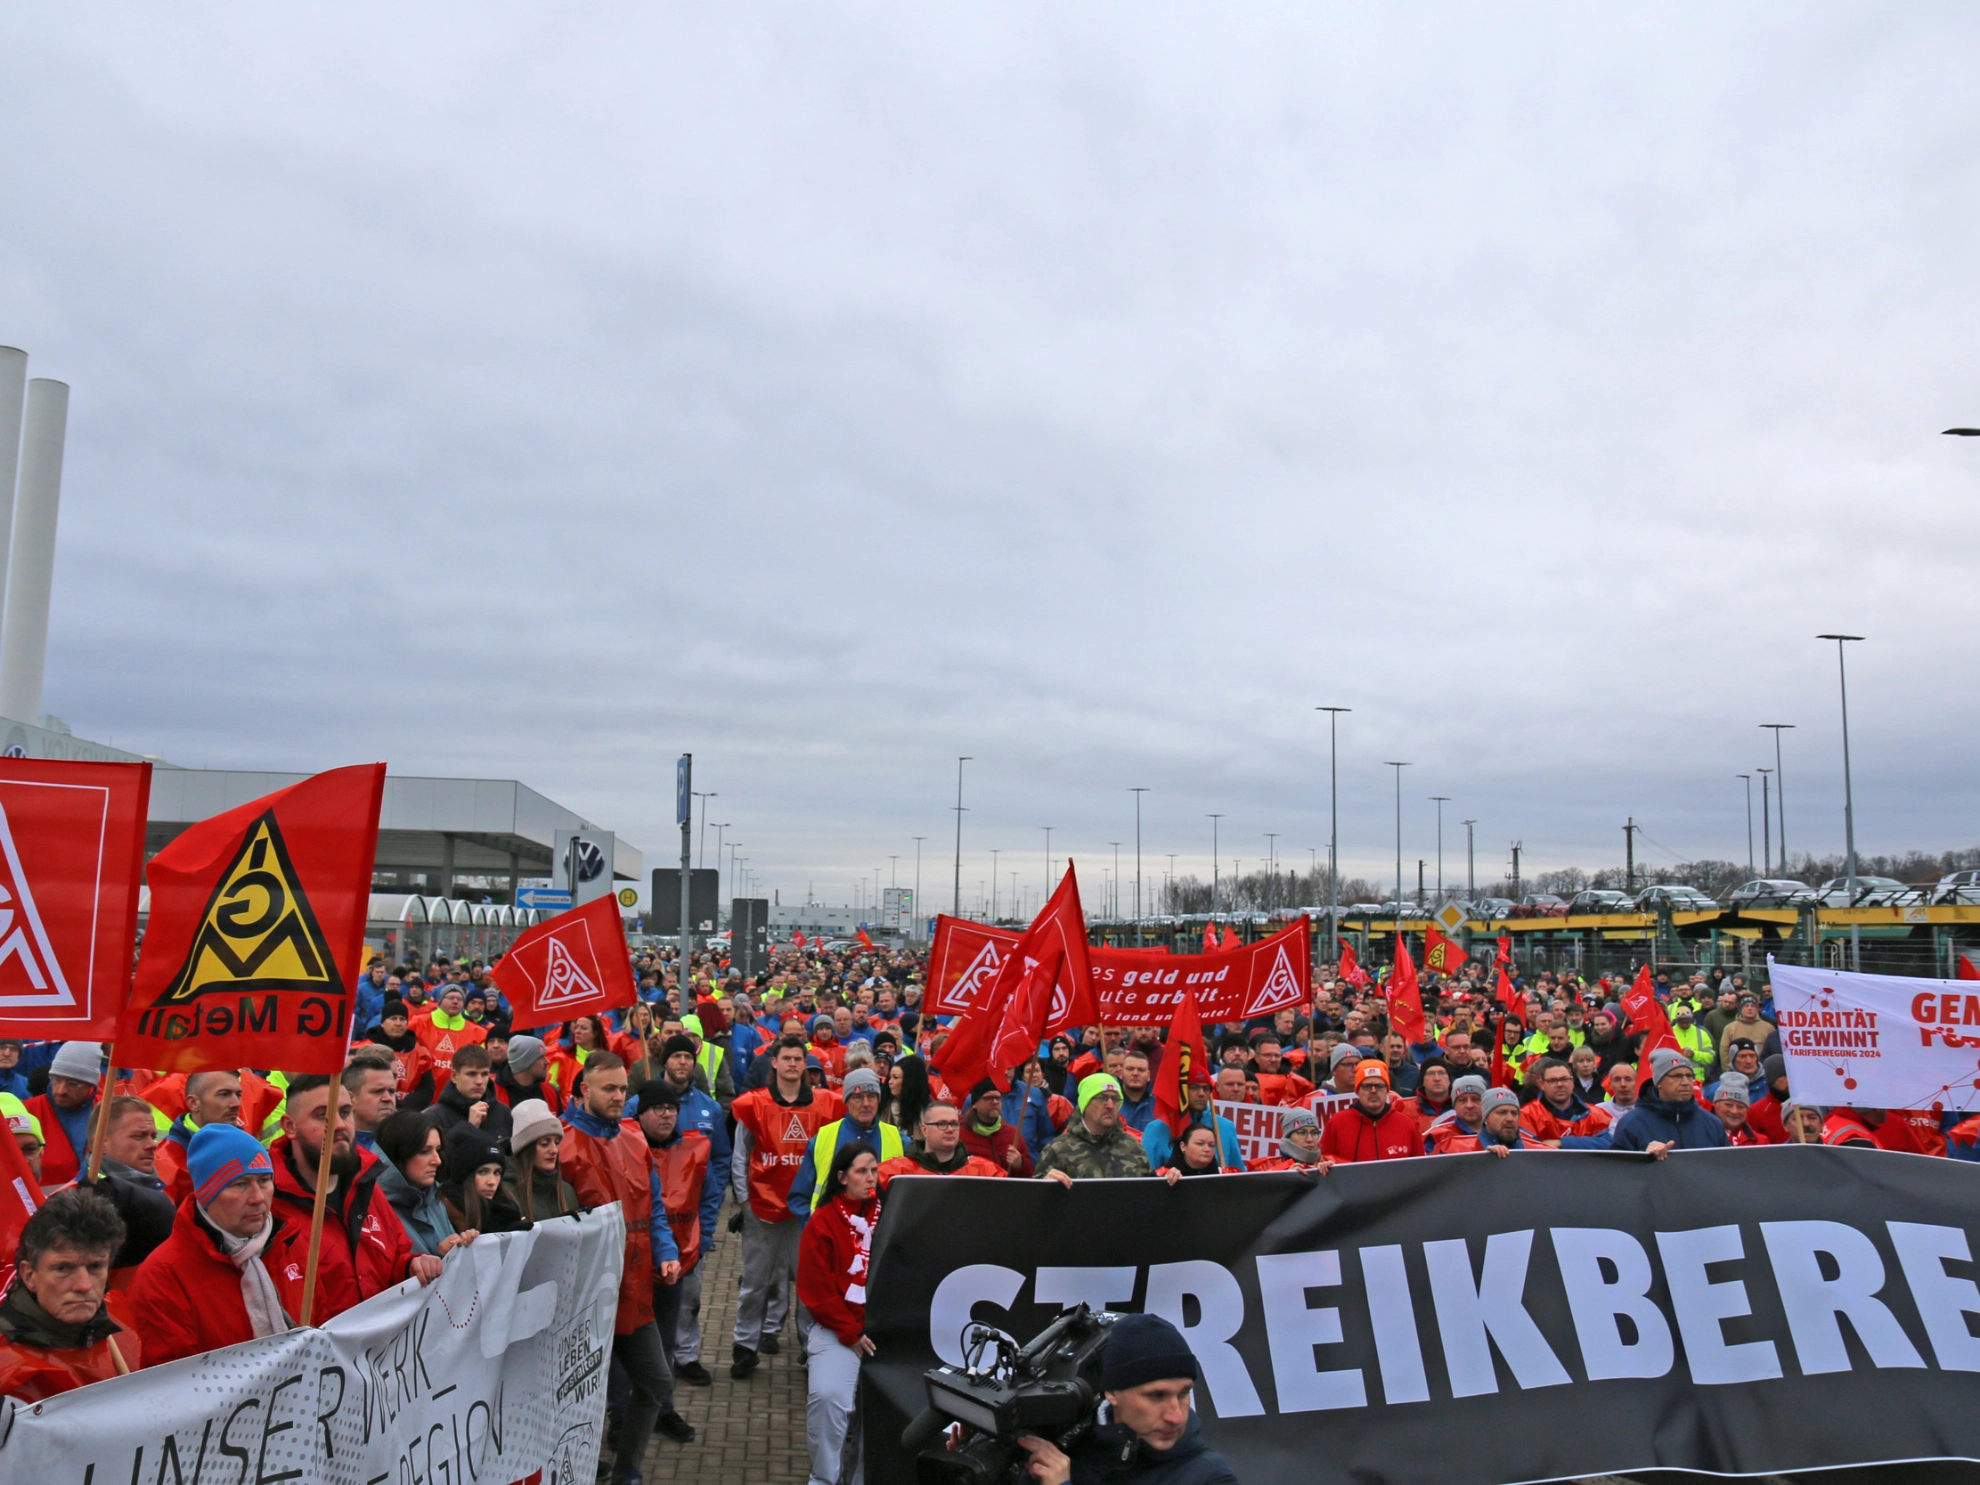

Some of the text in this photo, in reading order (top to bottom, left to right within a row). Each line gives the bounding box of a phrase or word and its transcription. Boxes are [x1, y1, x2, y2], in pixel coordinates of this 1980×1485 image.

[1121, 968, 1180, 987] geld
[1186, 965, 1230, 984] und
[1115, 1012, 1151, 1021] land
[1788, 1029, 1880, 1048] GEWINNT
[1789, 1048, 1882, 1058] TARIFBEWEGUNG 2024
[559, 1318, 591, 1359] UNSER
[559, 1336, 591, 1378] LEBEN
[558, 1350, 601, 1402] gestalten
